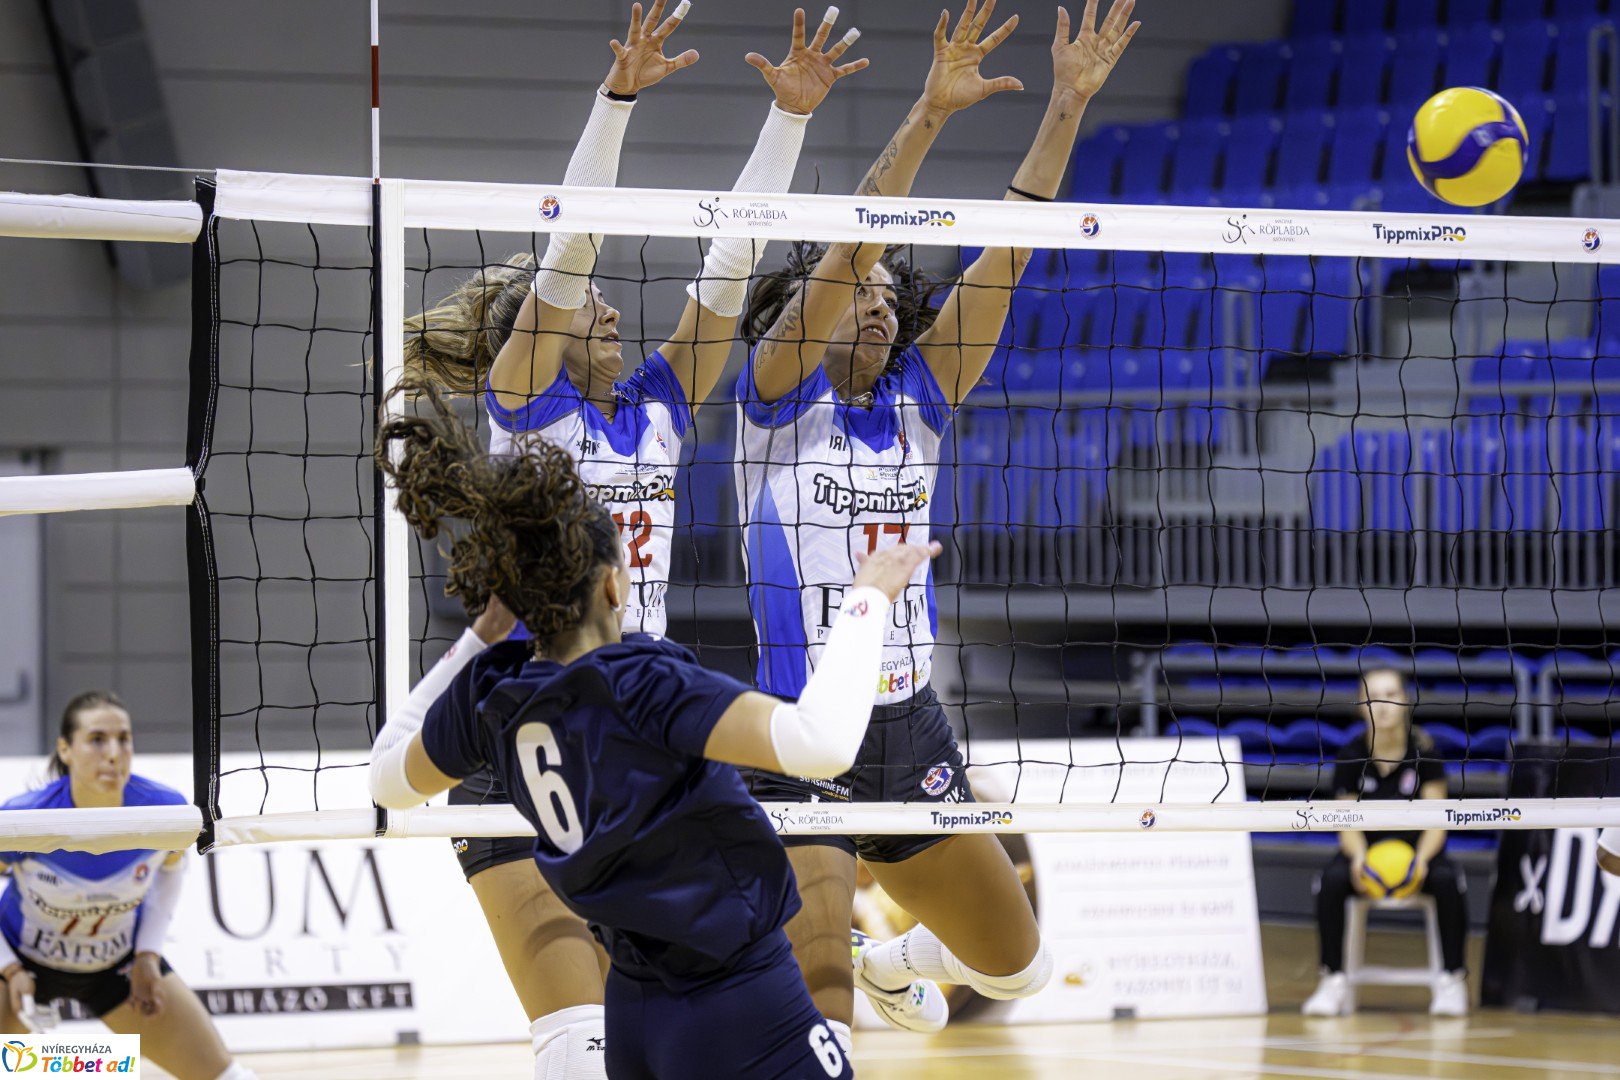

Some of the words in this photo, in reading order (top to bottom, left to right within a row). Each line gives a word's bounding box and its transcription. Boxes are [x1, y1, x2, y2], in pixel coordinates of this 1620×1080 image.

[732, 207, 788, 220] RÖPLABDA
[855, 207, 956, 229] TippmixPRO
[1259, 223, 1310, 236] RÖPLABDA
[1372, 223, 1467, 244] TippmixPRO
[516, 721, 584, 856] 6
[798, 815, 844, 825] RÖPLABDA
[930, 811, 1013, 829] TippmixPRO
[1322, 813, 1364, 823] RÖPLABDA
[1445, 808, 1522, 826] TippmixPRO
[200, 848, 405, 941] UM
[808, 1024, 843, 1078] 6
